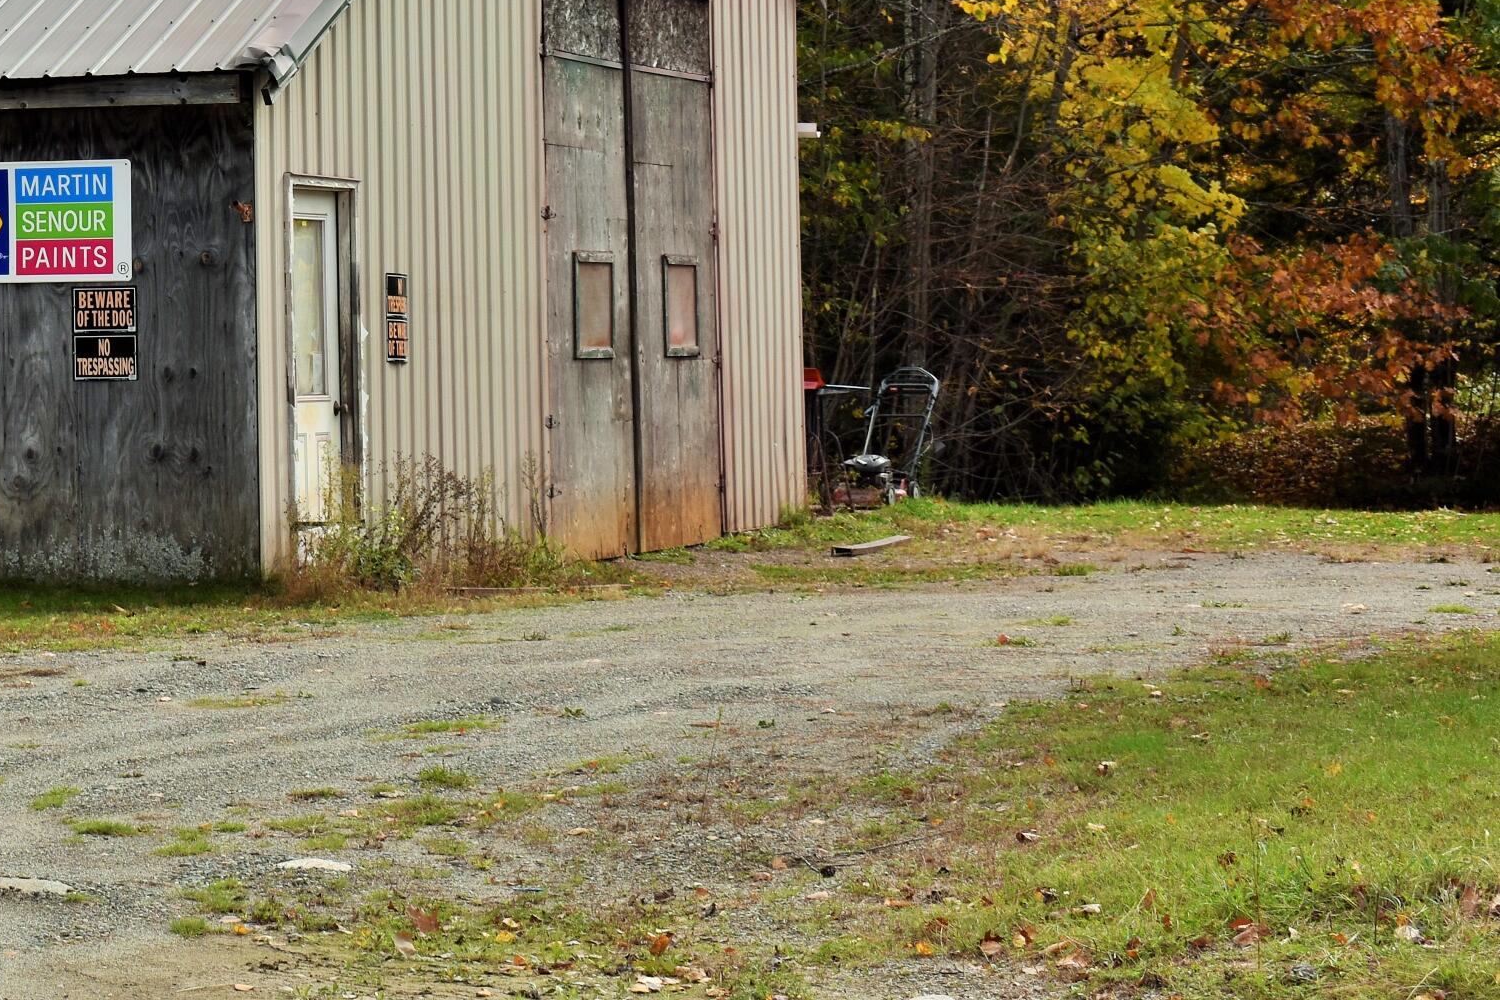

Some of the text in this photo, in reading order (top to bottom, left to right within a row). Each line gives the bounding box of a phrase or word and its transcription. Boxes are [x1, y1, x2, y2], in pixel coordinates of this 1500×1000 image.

[21, 174, 107, 197] MARTIN
[22, 210, 106, 233] SENOUR
[22, 245, 107, 269] PAINTS
[78, 291, 131, 309] BEWARE
[77, 310, 133, 327] OF THE DOG
[98, 338, 110, 357] NO
[77, 357, 134, 376] TRESPASSING
